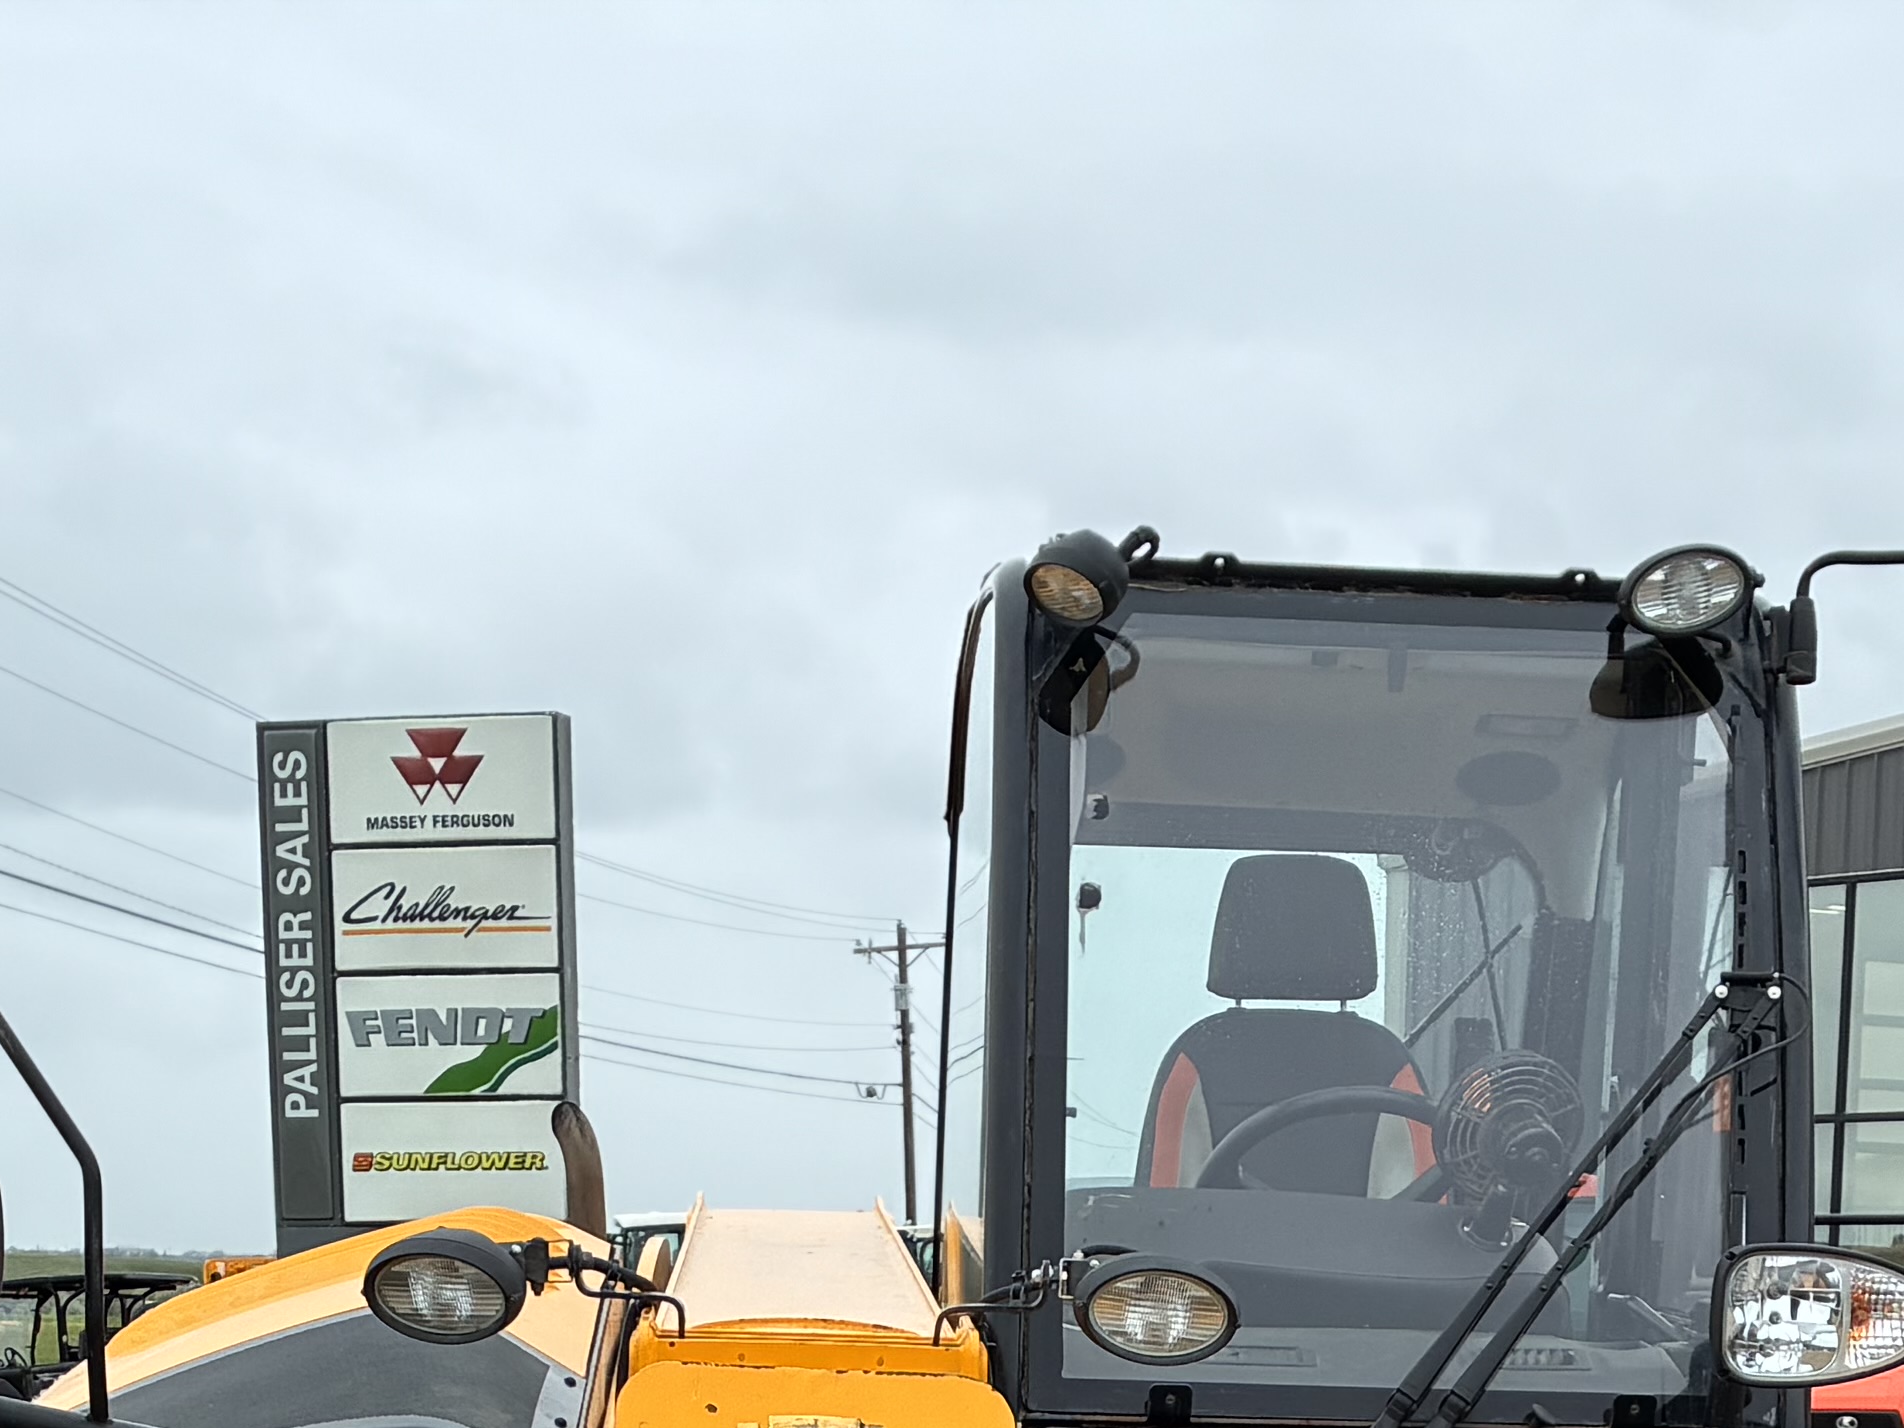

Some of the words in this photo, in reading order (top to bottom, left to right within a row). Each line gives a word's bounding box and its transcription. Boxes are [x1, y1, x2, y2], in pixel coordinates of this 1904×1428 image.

[273, 750, 312, 896] SALES
[366, 815, 428, 830] MASSEY
[432, 813, 515, 829] FERGUSON
[342, 882, 552, 938] Challenger
[278, 910, 319, 1118] PALLISER
[345, 1007, 546, 1047] FENDT
[372, 1152, 546, 1171] SUNFLOWER
